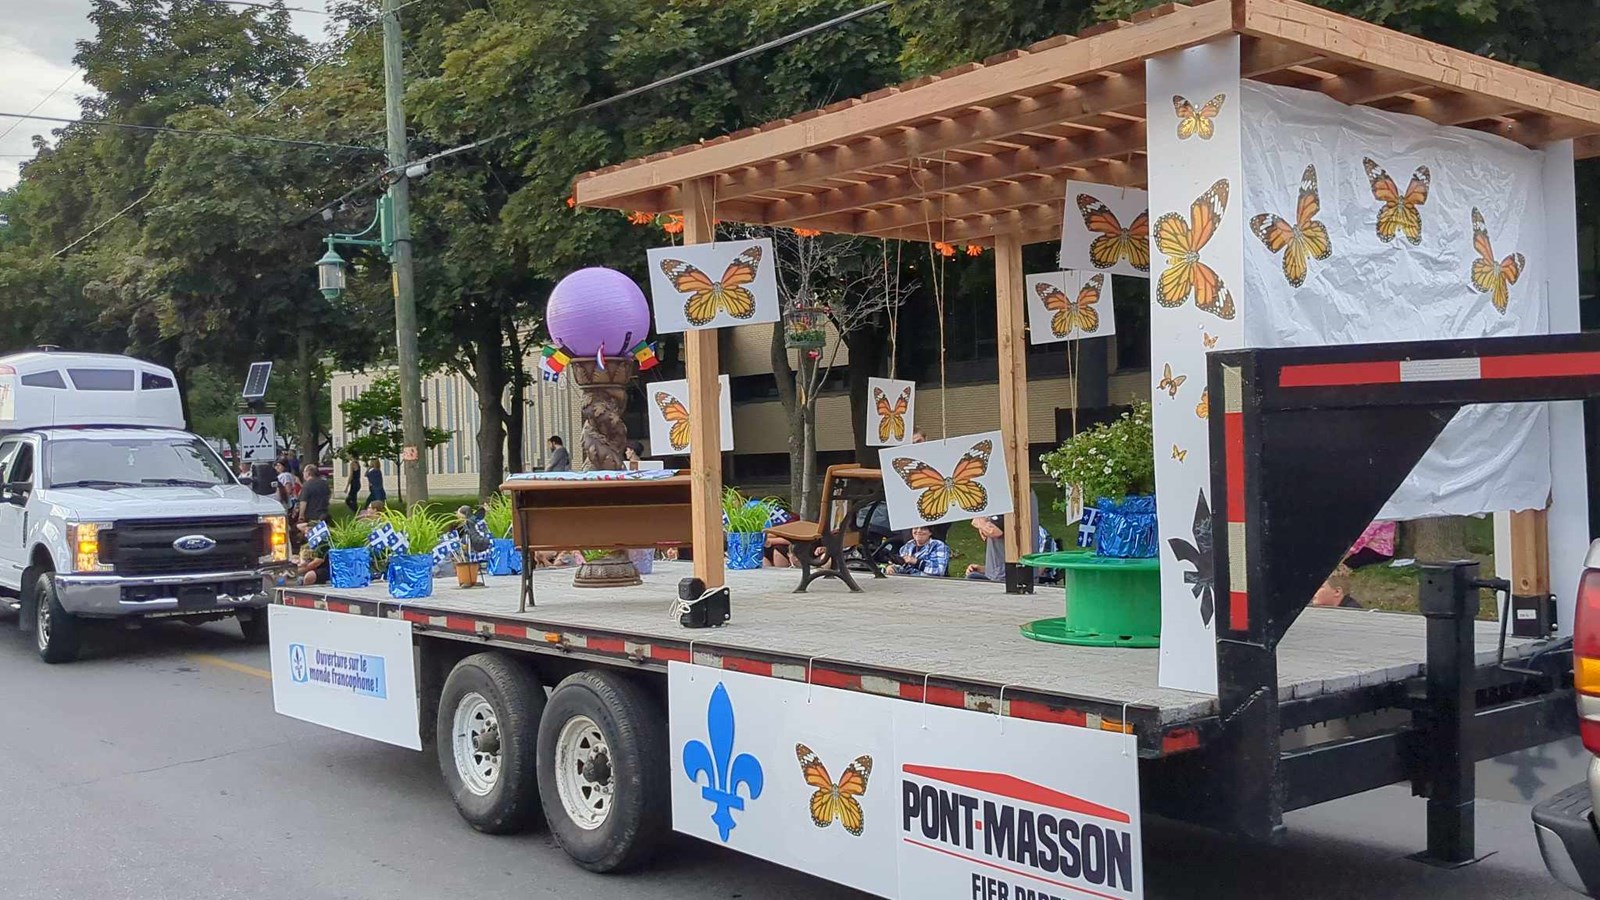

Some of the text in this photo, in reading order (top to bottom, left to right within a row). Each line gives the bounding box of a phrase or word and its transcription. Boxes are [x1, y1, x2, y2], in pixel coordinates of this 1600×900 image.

[316, 649, 367, 673] Ouverture sur le
[309, 667, 331, 684] monde
[332, 668, 375, 693] francophone
